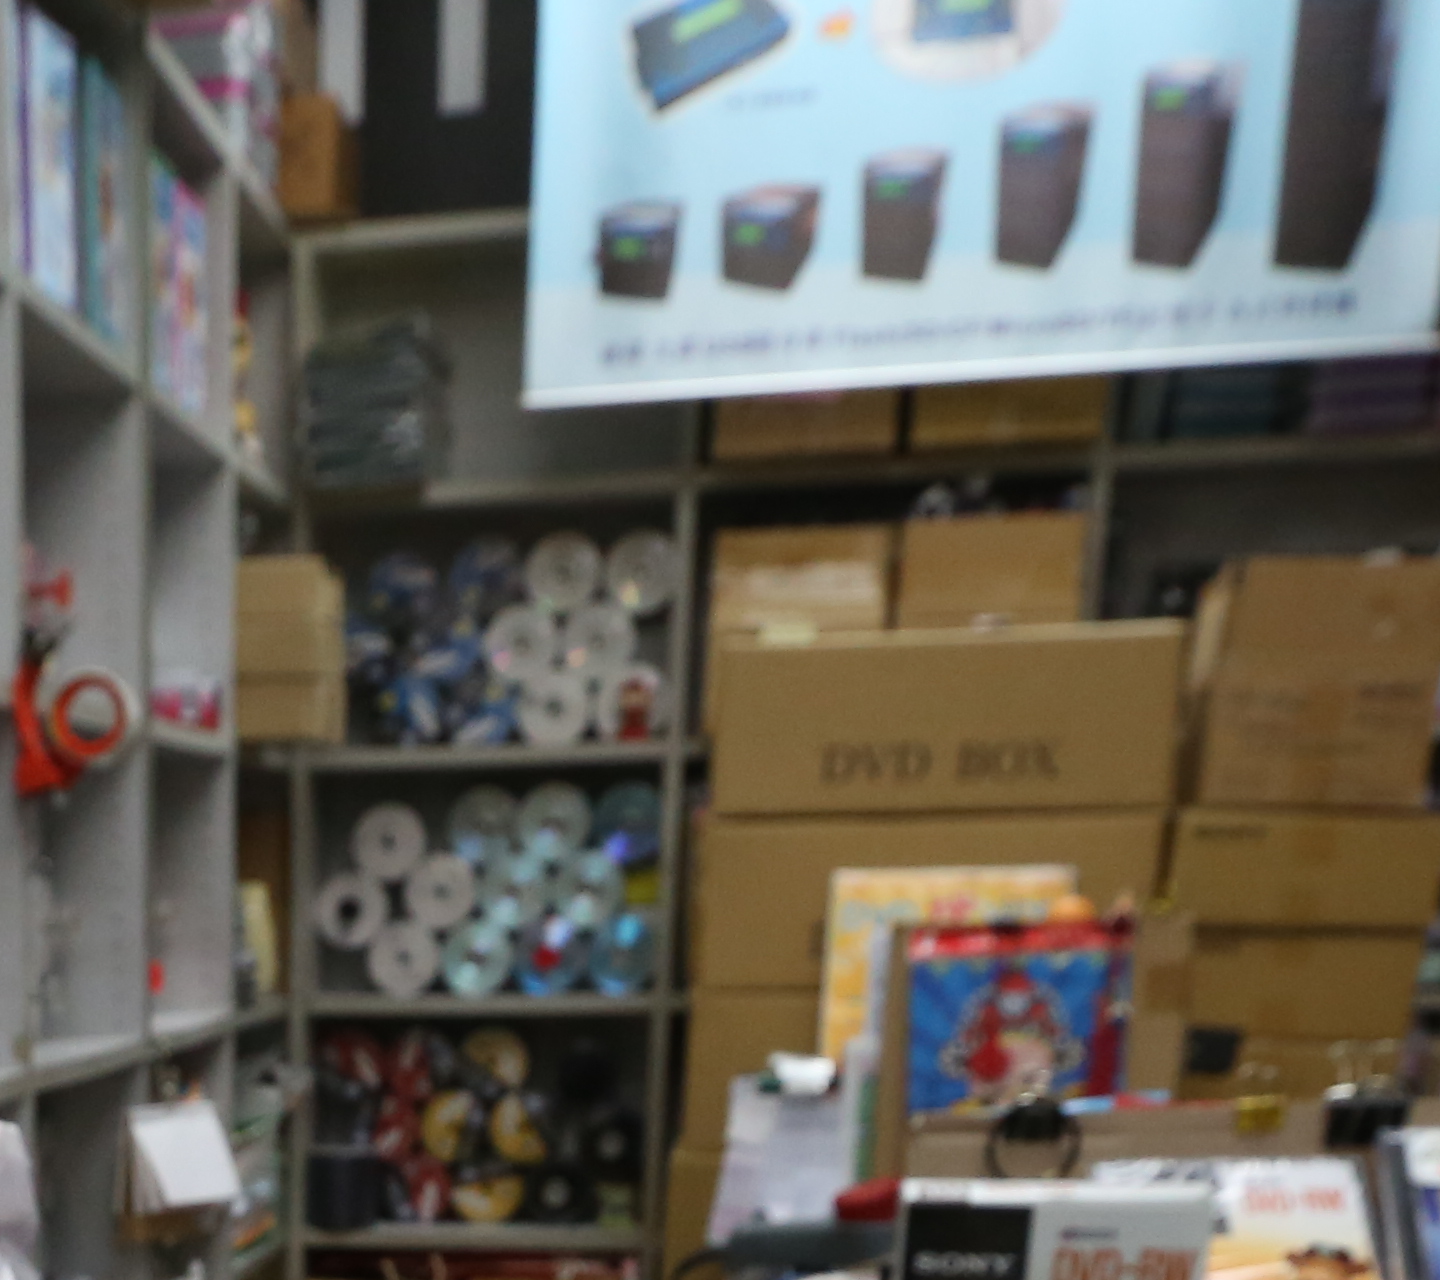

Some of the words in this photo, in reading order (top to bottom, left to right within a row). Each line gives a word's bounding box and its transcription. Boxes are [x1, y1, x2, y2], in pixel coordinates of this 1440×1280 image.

[820, 740, 931, 784] DVD
[955, 737, 1062, 781] BOX
[914, 1251, 1012, 1277] SONY
